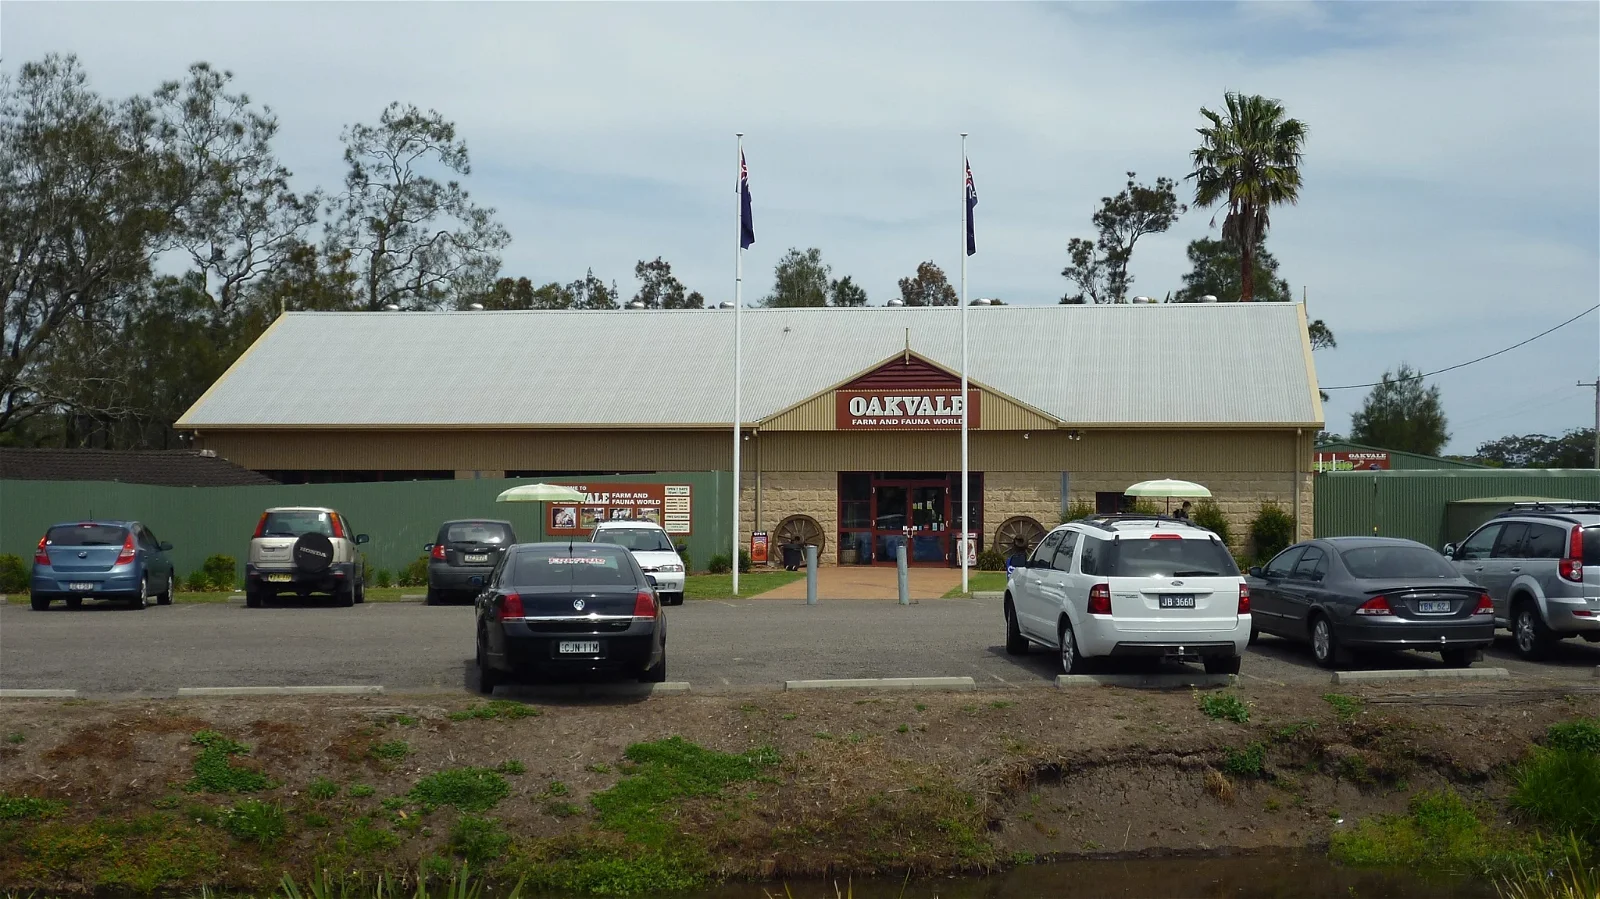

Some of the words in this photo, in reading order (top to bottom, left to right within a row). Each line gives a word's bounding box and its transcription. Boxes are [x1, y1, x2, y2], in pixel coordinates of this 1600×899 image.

[849, 396, 962, 416] OAKVALE
[300, 546, 326, 558] HONDA
[1161, 597, 1173, 606] JB
[1175, 597, 1194, 606] 3660
[564, 643, 580, 652] CJN
[583, 643, 598, 652] 11M
